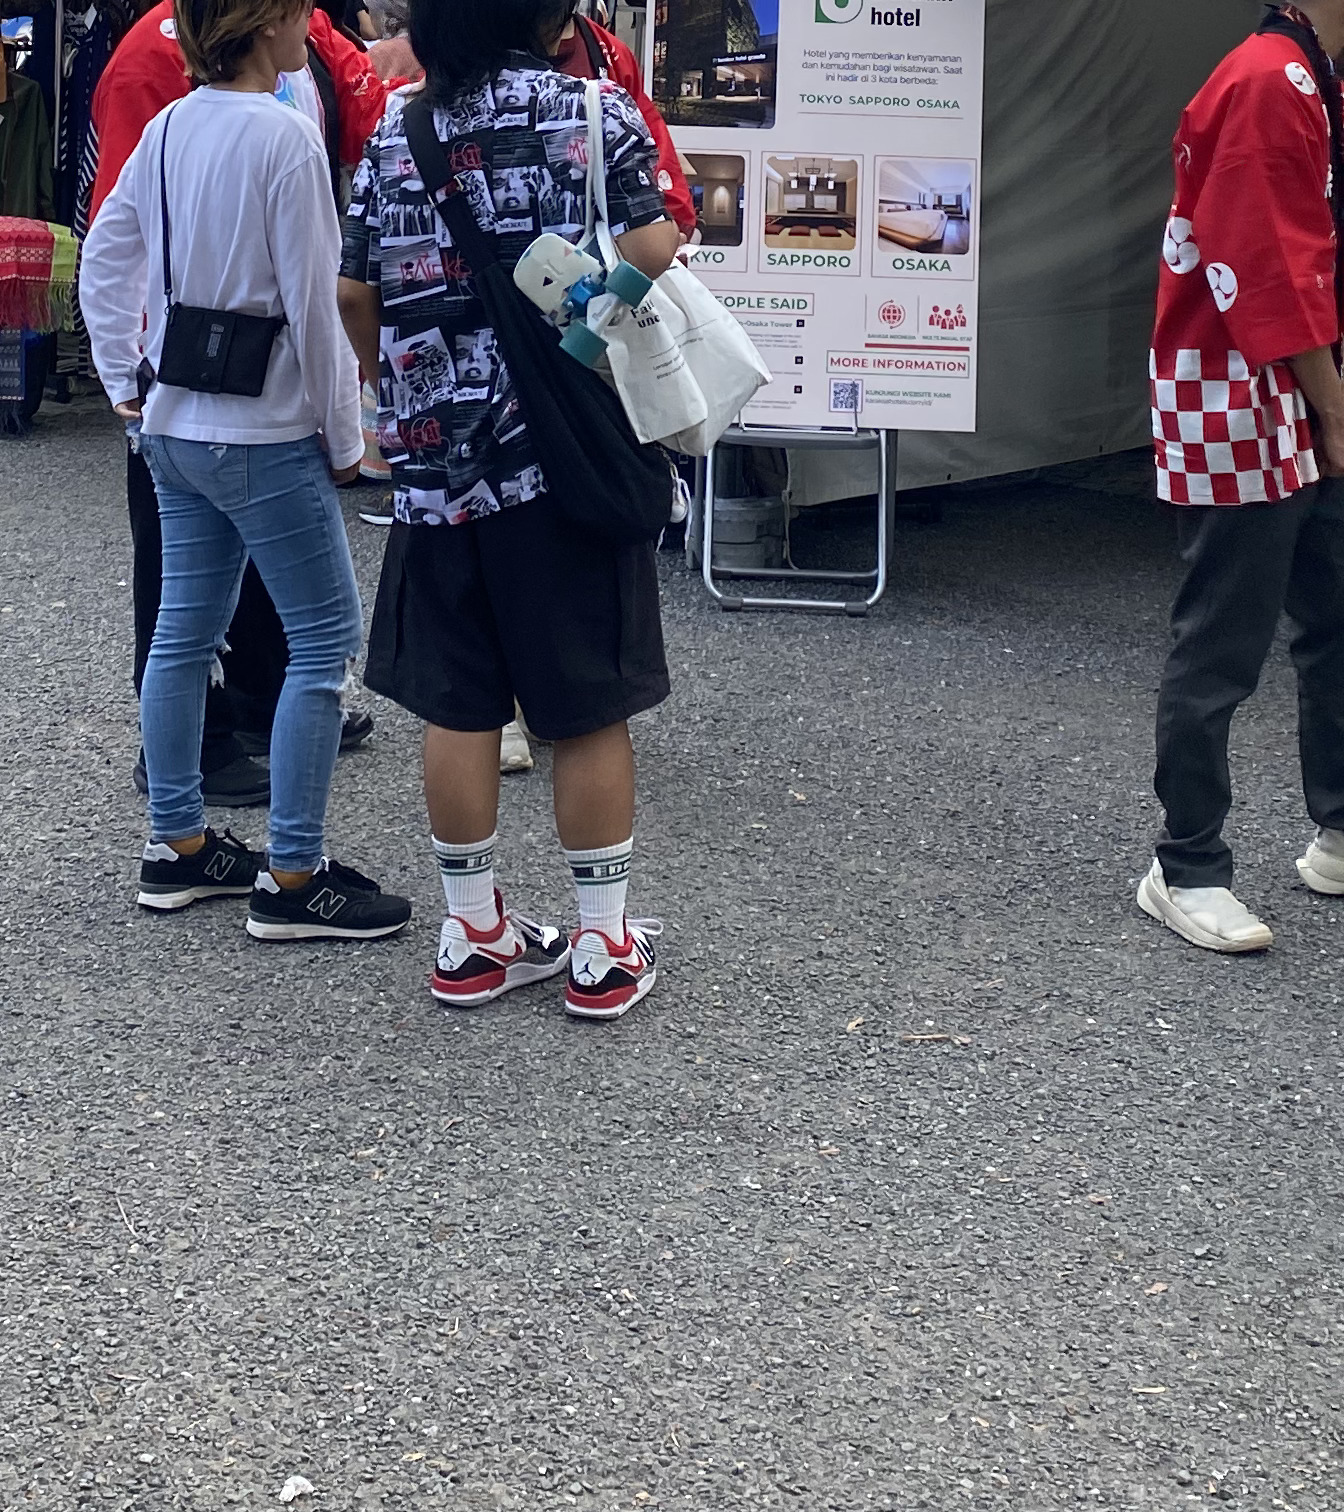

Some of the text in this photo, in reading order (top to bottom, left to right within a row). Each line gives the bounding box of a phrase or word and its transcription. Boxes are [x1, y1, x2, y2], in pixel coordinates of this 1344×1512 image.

[870, 7, 920, 26] hotel
[803, 49, 827, 58] Hotel
[828, 51, 850, 61] yang
[802, 61, 818, 69] dan
[820, 62, 871, 71] kemudahan
[873, 63, 891, 73] bagi
[943, 65, 963, 75] Saat
[825, 73, 835, 81] ini
[837, 73, 858, 82] hadir
[861, 74, 869, 83] di
[870, 75, 877, 83] 3
[879, 75, 898, 84] kota
[799, 93, 960, 109] TOKYO SAPPORO OSAKA
[690, 251, 726, 265] KYO
[766, 253, 851, 268] SAPPORO
[892, 257, 953, 272] OSAKA
[770, 297, 809, 311] SAID
[830, 356, 967, 372] MORE INFORMATION
